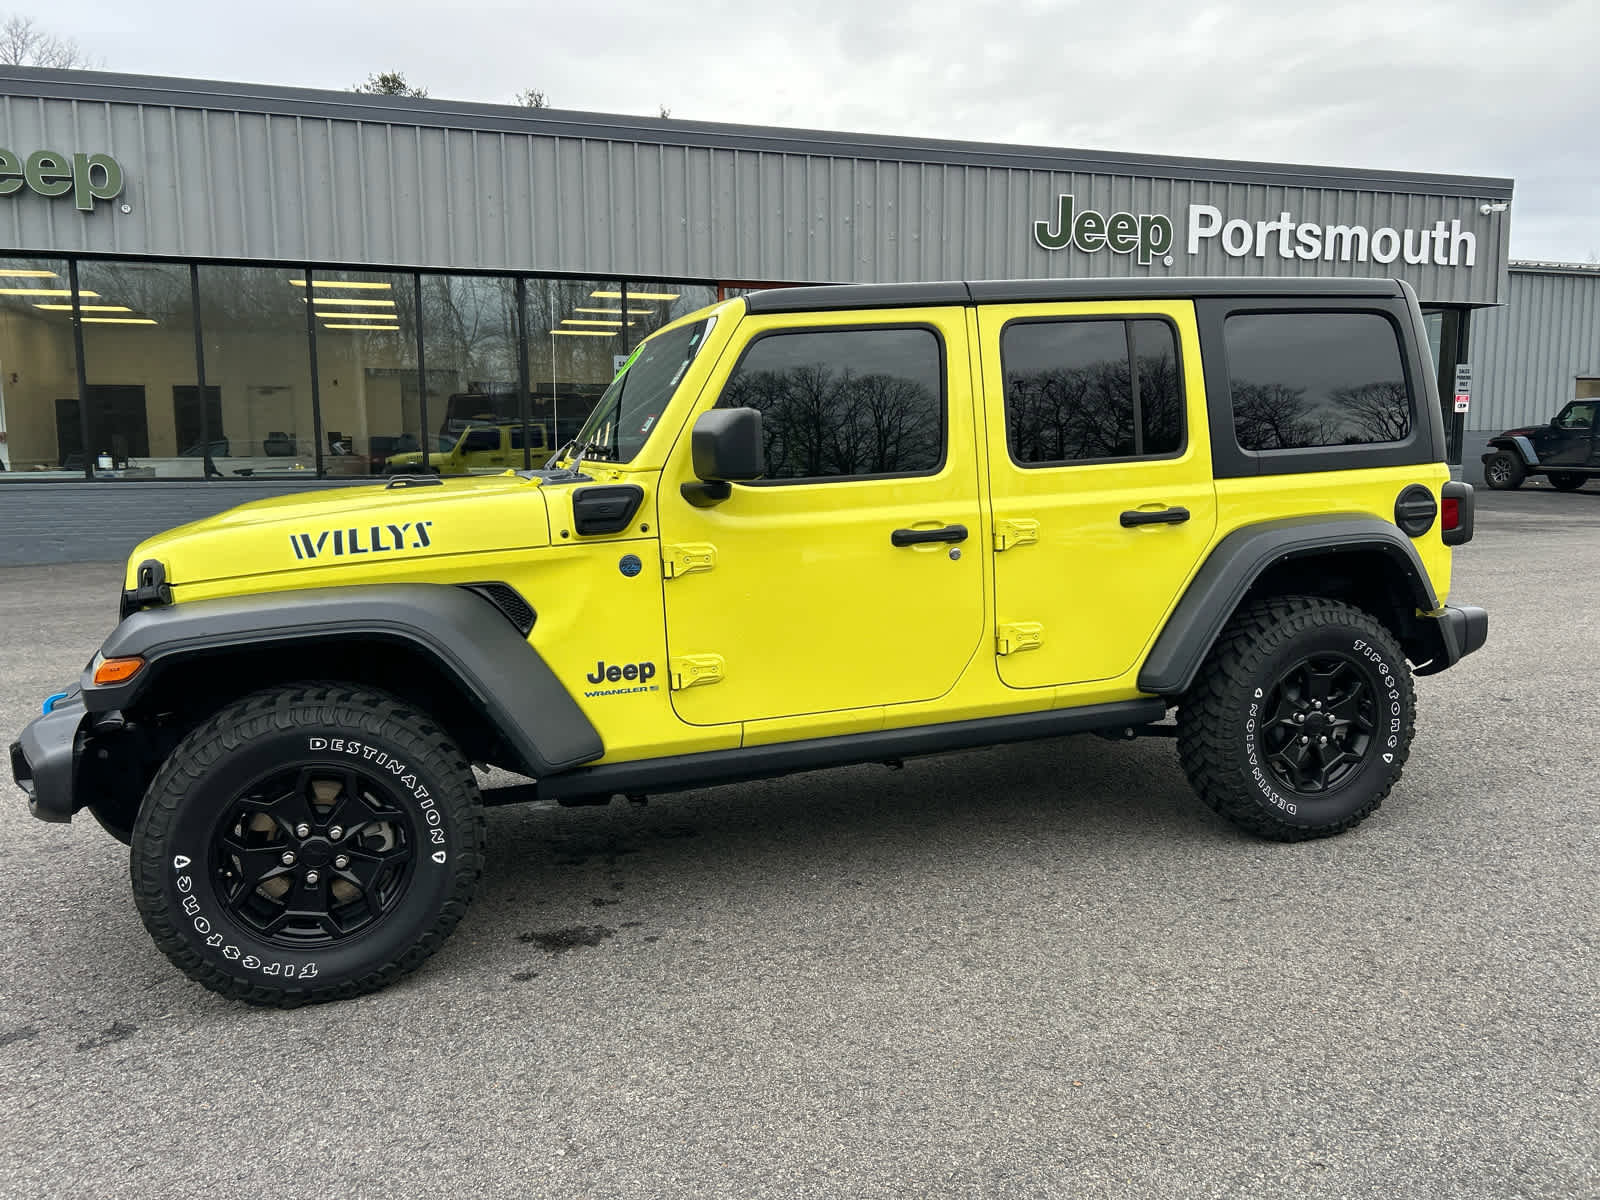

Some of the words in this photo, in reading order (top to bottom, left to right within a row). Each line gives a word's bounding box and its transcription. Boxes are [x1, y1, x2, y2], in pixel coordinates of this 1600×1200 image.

[1034, 194, 1173, 265] Jeep
[1187, 204, 1477, 268] Portsmouth
[289, 521, 433, 560] WILLYS
[584, 685, 649, 698] WRANGLER
[586, 661, 656, 684] Jeep
[1246, 703, 1297, 816] DESTINATION
[309, 737, 447, 845] DESTINATION
